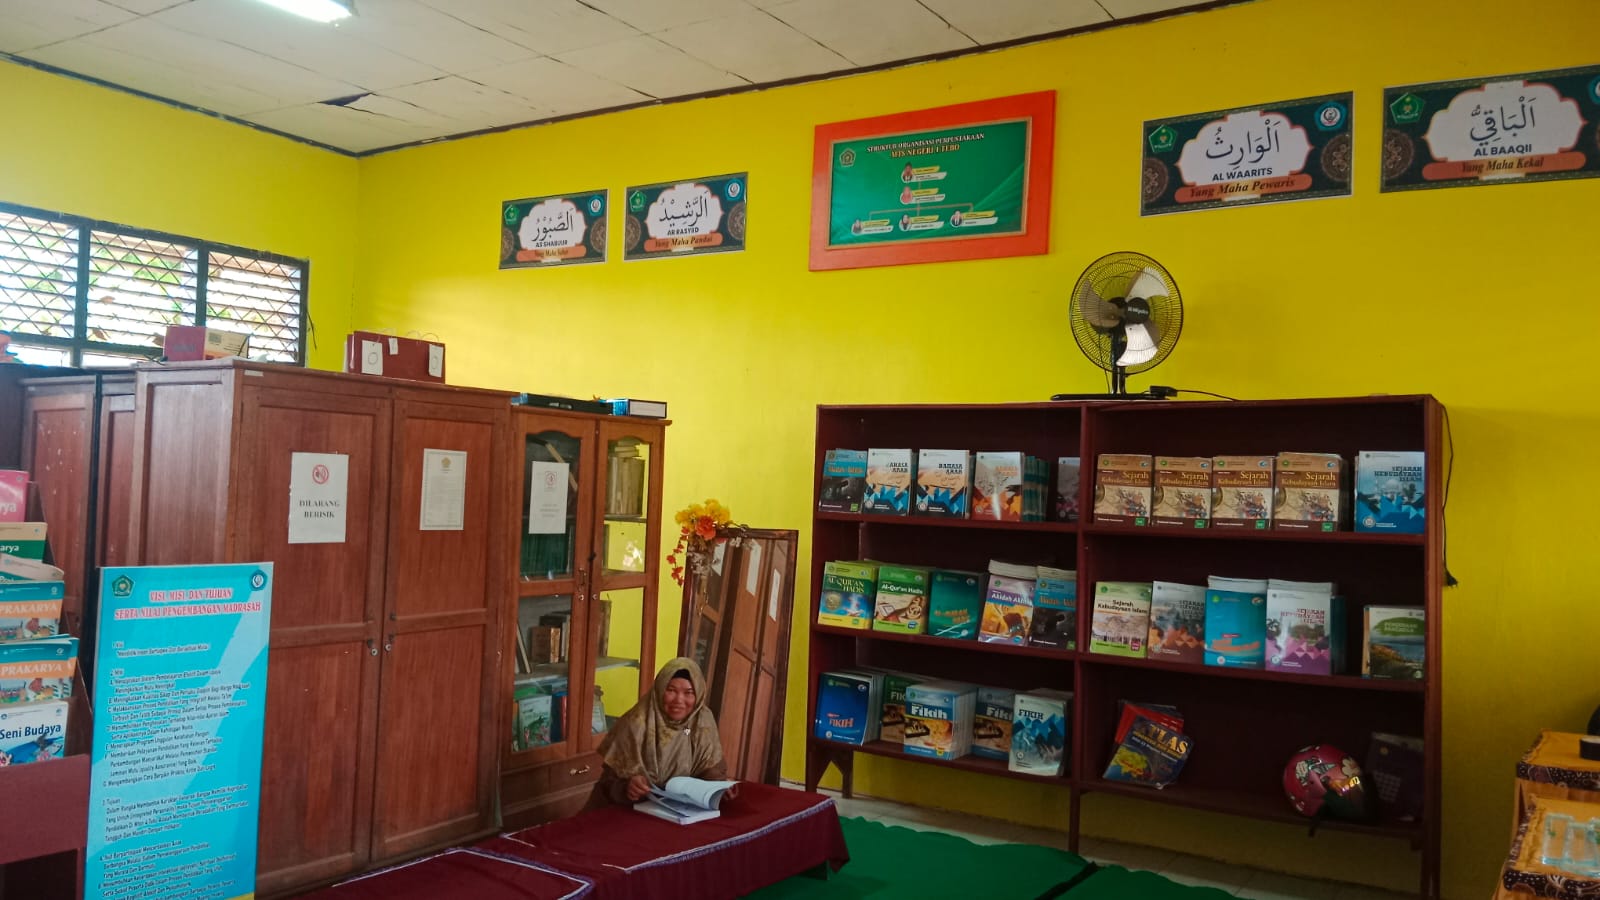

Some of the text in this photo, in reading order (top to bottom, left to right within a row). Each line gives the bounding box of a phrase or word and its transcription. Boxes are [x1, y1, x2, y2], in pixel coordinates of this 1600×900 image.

[867, 133, 985, 153] STRUKTUR ORGANISASI PERPUSTAKAAN
[905, 147, 933, 157] NEGERI
[941, 143, 961, 153] TEBO
[1474, 144, 1533, 158] AL BAAQII
[1462, 157, 1544, 174] Yang Maha Kekal
[1227, 168, 1273, 181] WAARITS
[1190, 179, 1296, 199] Yang Maha Pewaris
[671, 237, 689, 246] Maha
[690, 235, 713, 245] Pandai
[1123, 471, 1150, 481] Sejarah
[1181, 472, 1209, 481] Sejarah
[1240, 472, 1269, 482] Sejarah
[1306, 471, 1336, 482] Sejarah
[299, 500, 341, 508] DILARANG
[304, 511, 336, 519] BERISIK
[188, 589, 203, 599] DAN
[204, 587, 232, 599] TUJUAN
[1112, 599, 1134, 608] Sejarah
[115, 601, 262, 620] SERTA NILAI PENGEMBANGAN MADRASAH
[1, 662, 63, 677] PRAKARYA
[911, 704, 948, 720] Fikih
[1018, 709, 1044, 720] FIKIH
[829, 717, 854, 728] FIKIH
[25, 724, 62, 741] Budaya
